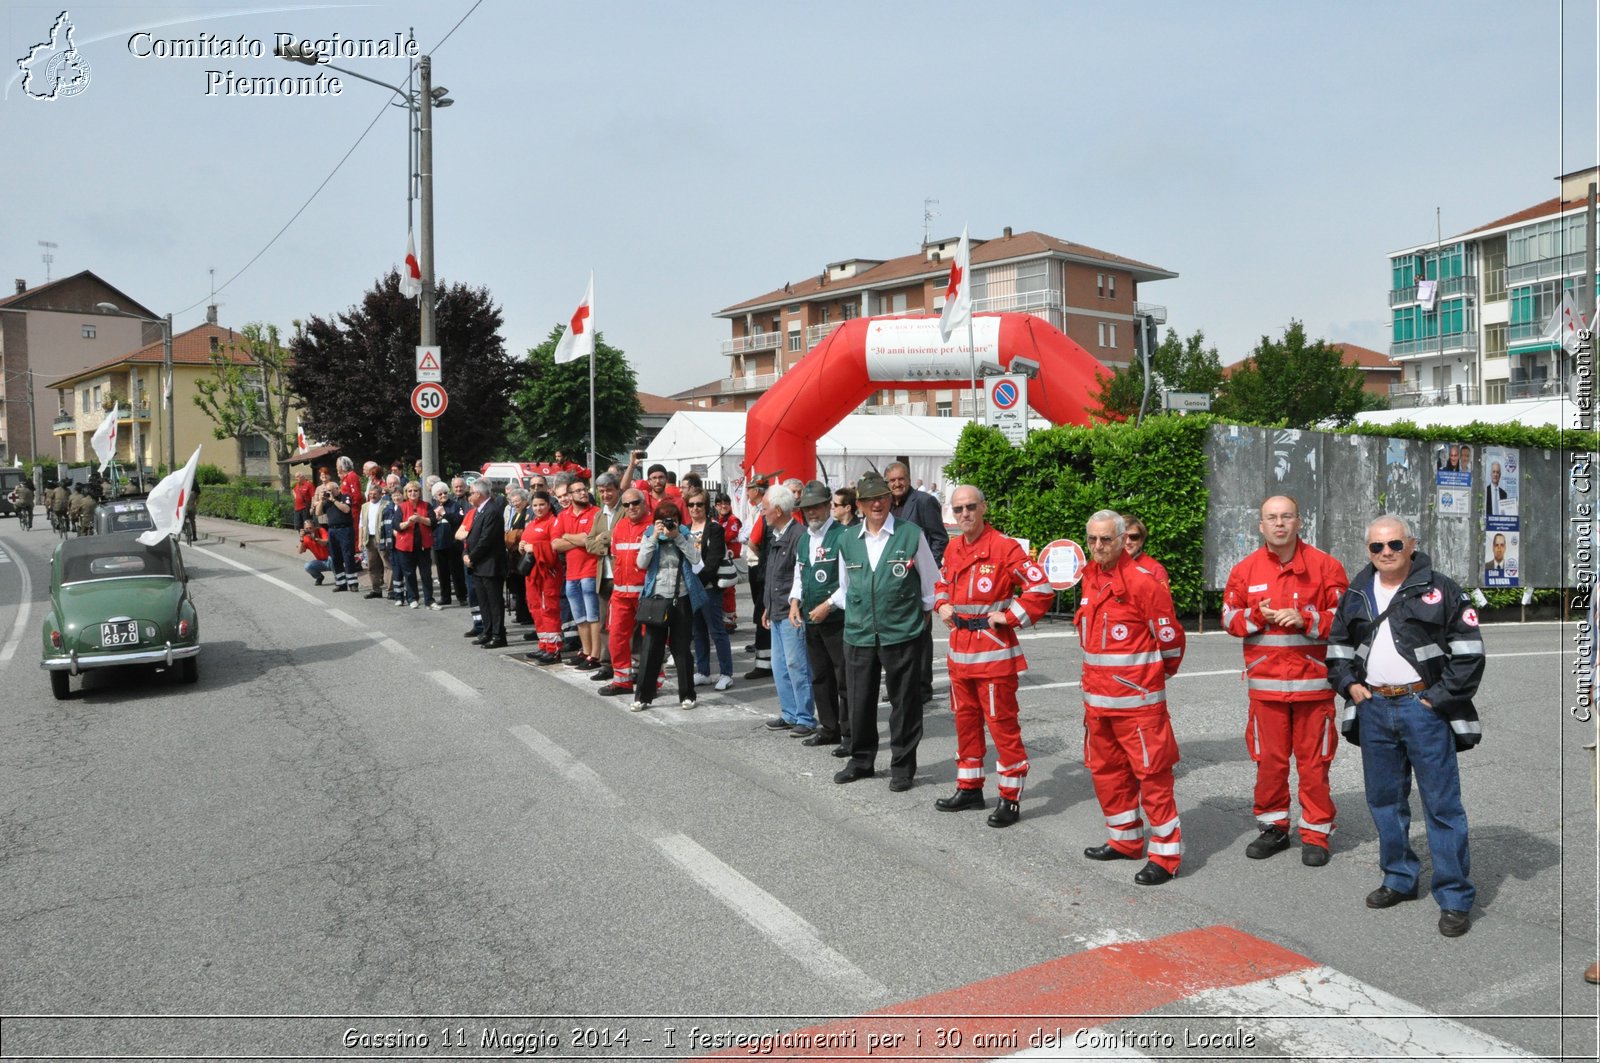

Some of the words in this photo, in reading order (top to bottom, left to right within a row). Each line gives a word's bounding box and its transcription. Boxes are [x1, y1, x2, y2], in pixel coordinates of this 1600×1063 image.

[887, 347, 906, 355] anni
[907, 346, 939, 354] insieme
[940, 346, 955, 356] per
[421, 392, 440, 408] 50
[105, 624, 118, 634] AT
[128, 623, 135, 632] 8
[105, 632, 136, 644] 6870
